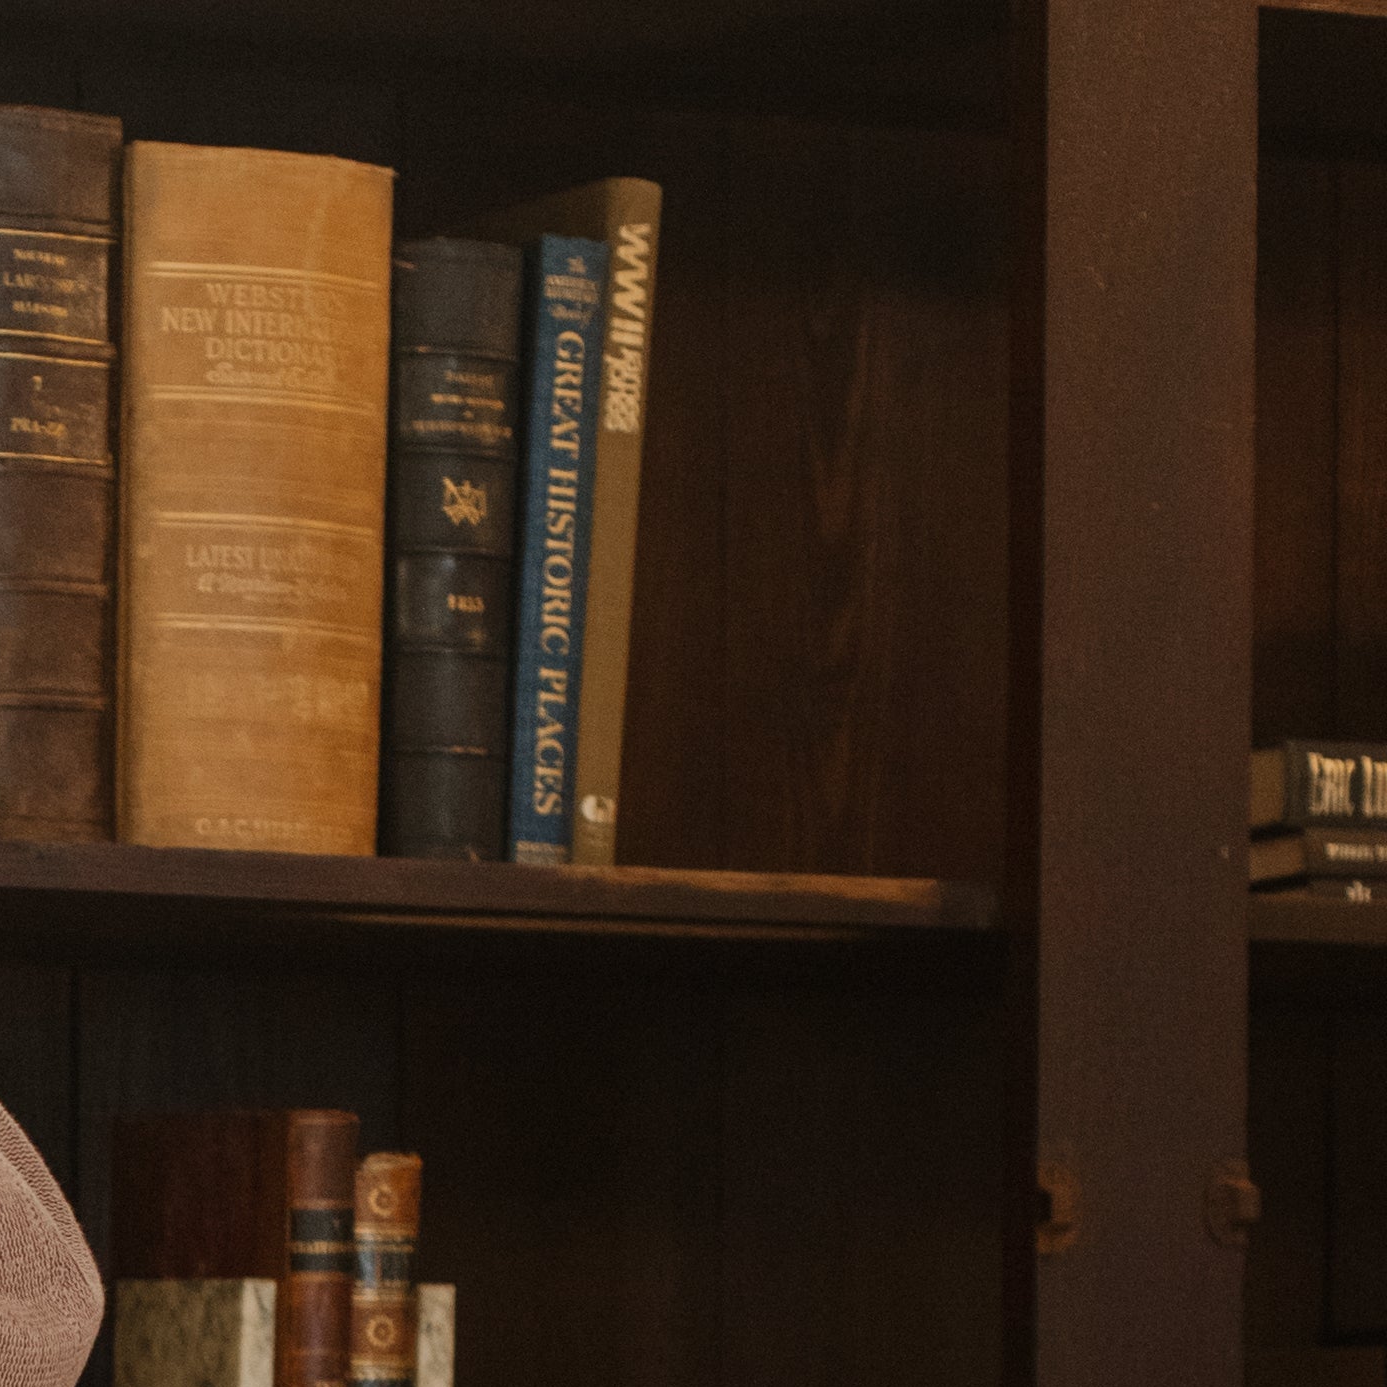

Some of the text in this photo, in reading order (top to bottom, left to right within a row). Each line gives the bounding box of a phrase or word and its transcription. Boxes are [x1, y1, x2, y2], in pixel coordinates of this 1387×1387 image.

[161, 306, 217, 334] NEW
[609, 222, 652, 347] WWII
[549, 331, 586, 460] GREAT
[542, 467, 580, 655] HISTORIC
[533, 667, 569, 816] PLACES
